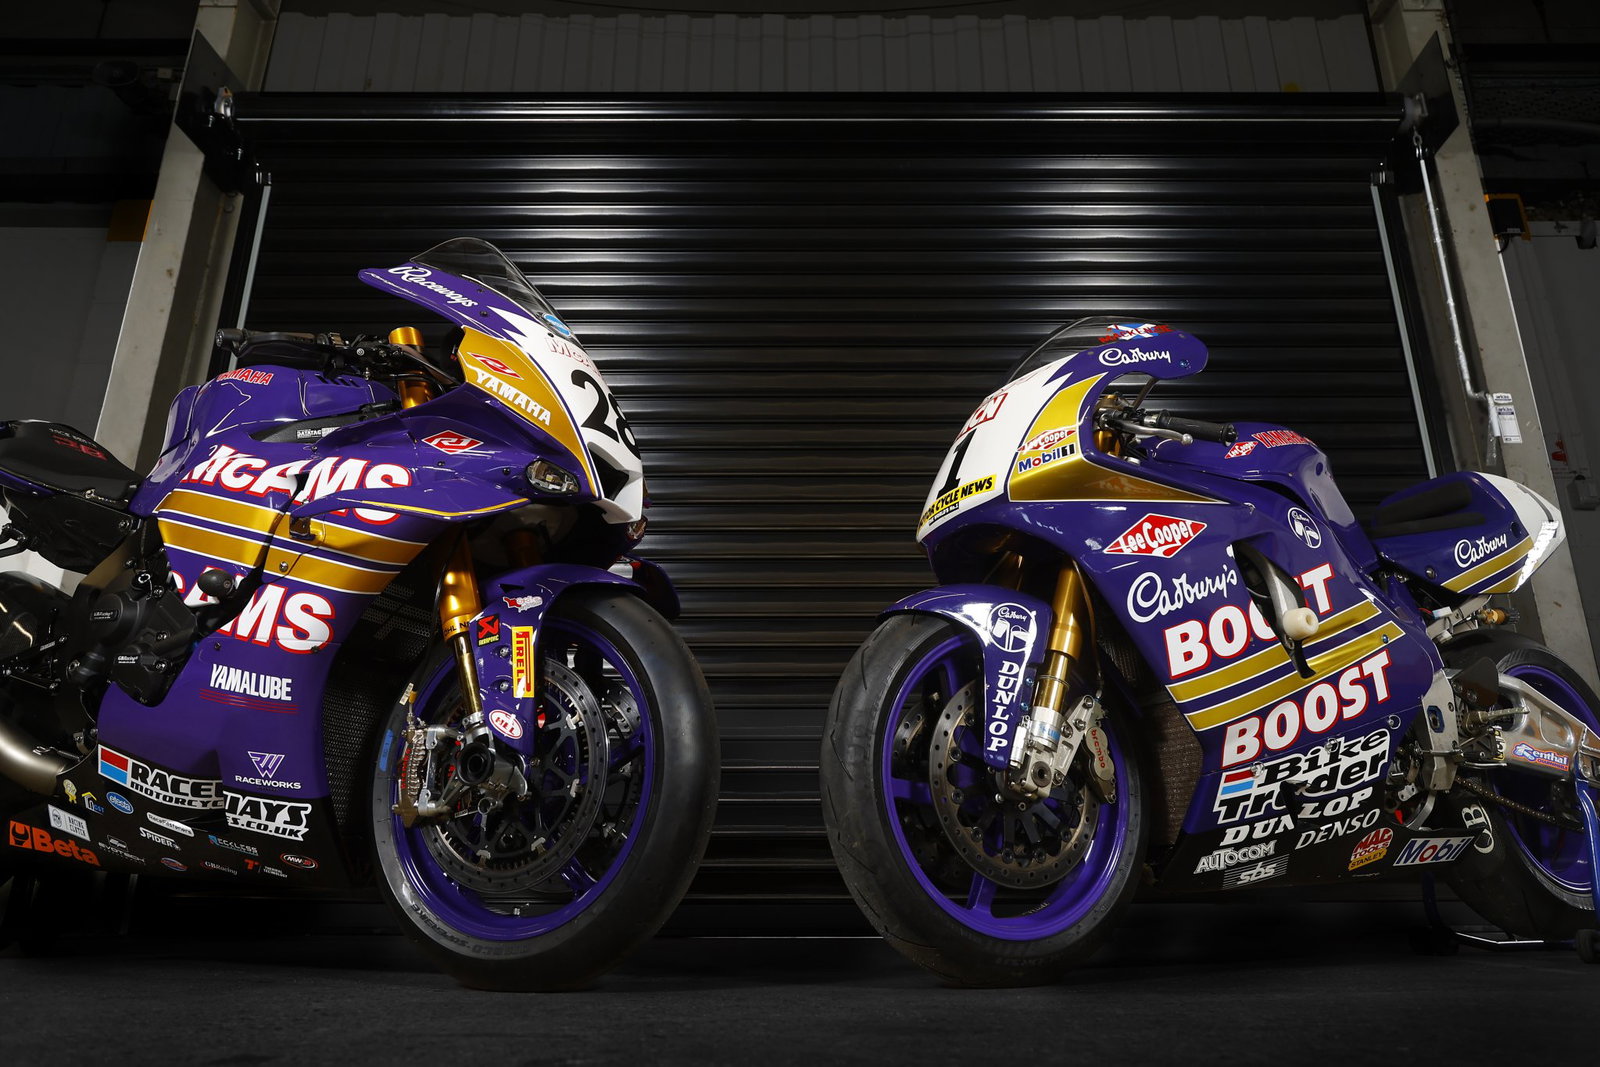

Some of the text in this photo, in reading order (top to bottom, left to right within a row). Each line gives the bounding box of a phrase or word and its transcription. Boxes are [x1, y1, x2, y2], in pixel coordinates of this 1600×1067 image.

[388, 266, 478, 307] Raceways
[1099, 347, 1171, 366] Cadbury
[475, 369, 551, 426] YAMAHA
[937, 428, 976, 499] 1
[936, 489, 959, 510] CYCLE
[960, 477, 992, 498] NEWS
[1454, 533, 1508, 568] Cadbury
[1126, 564, 1238, 623] Cadbury's
[997, 606, 1028, 623] Cadbury
[1164, 562, 1335, 680] BOOT
[209, 663, 293, 701] YAMALUBE
[987, 660, 1020, 752] DUNLOP
[1221, 649, 1392, 769] BOOST
[1256, 730, 1388, 787] Bike
[235, 775, 302, 790] RACEWORKS
[32, 826, 102, 868] Beta
[139, 826, 175, 849] SPIDER
[1295, 808, 1381, 850] DENSO
[1353, 827, 1392, 854] MAC
[1193, 839, 1278, 875] AUTOCOM
[1350, 852, 1385, 869] STANLEY
[1395, 837, 1472, 865] Mobil
[1236, 861, 1277, 885] sbs
